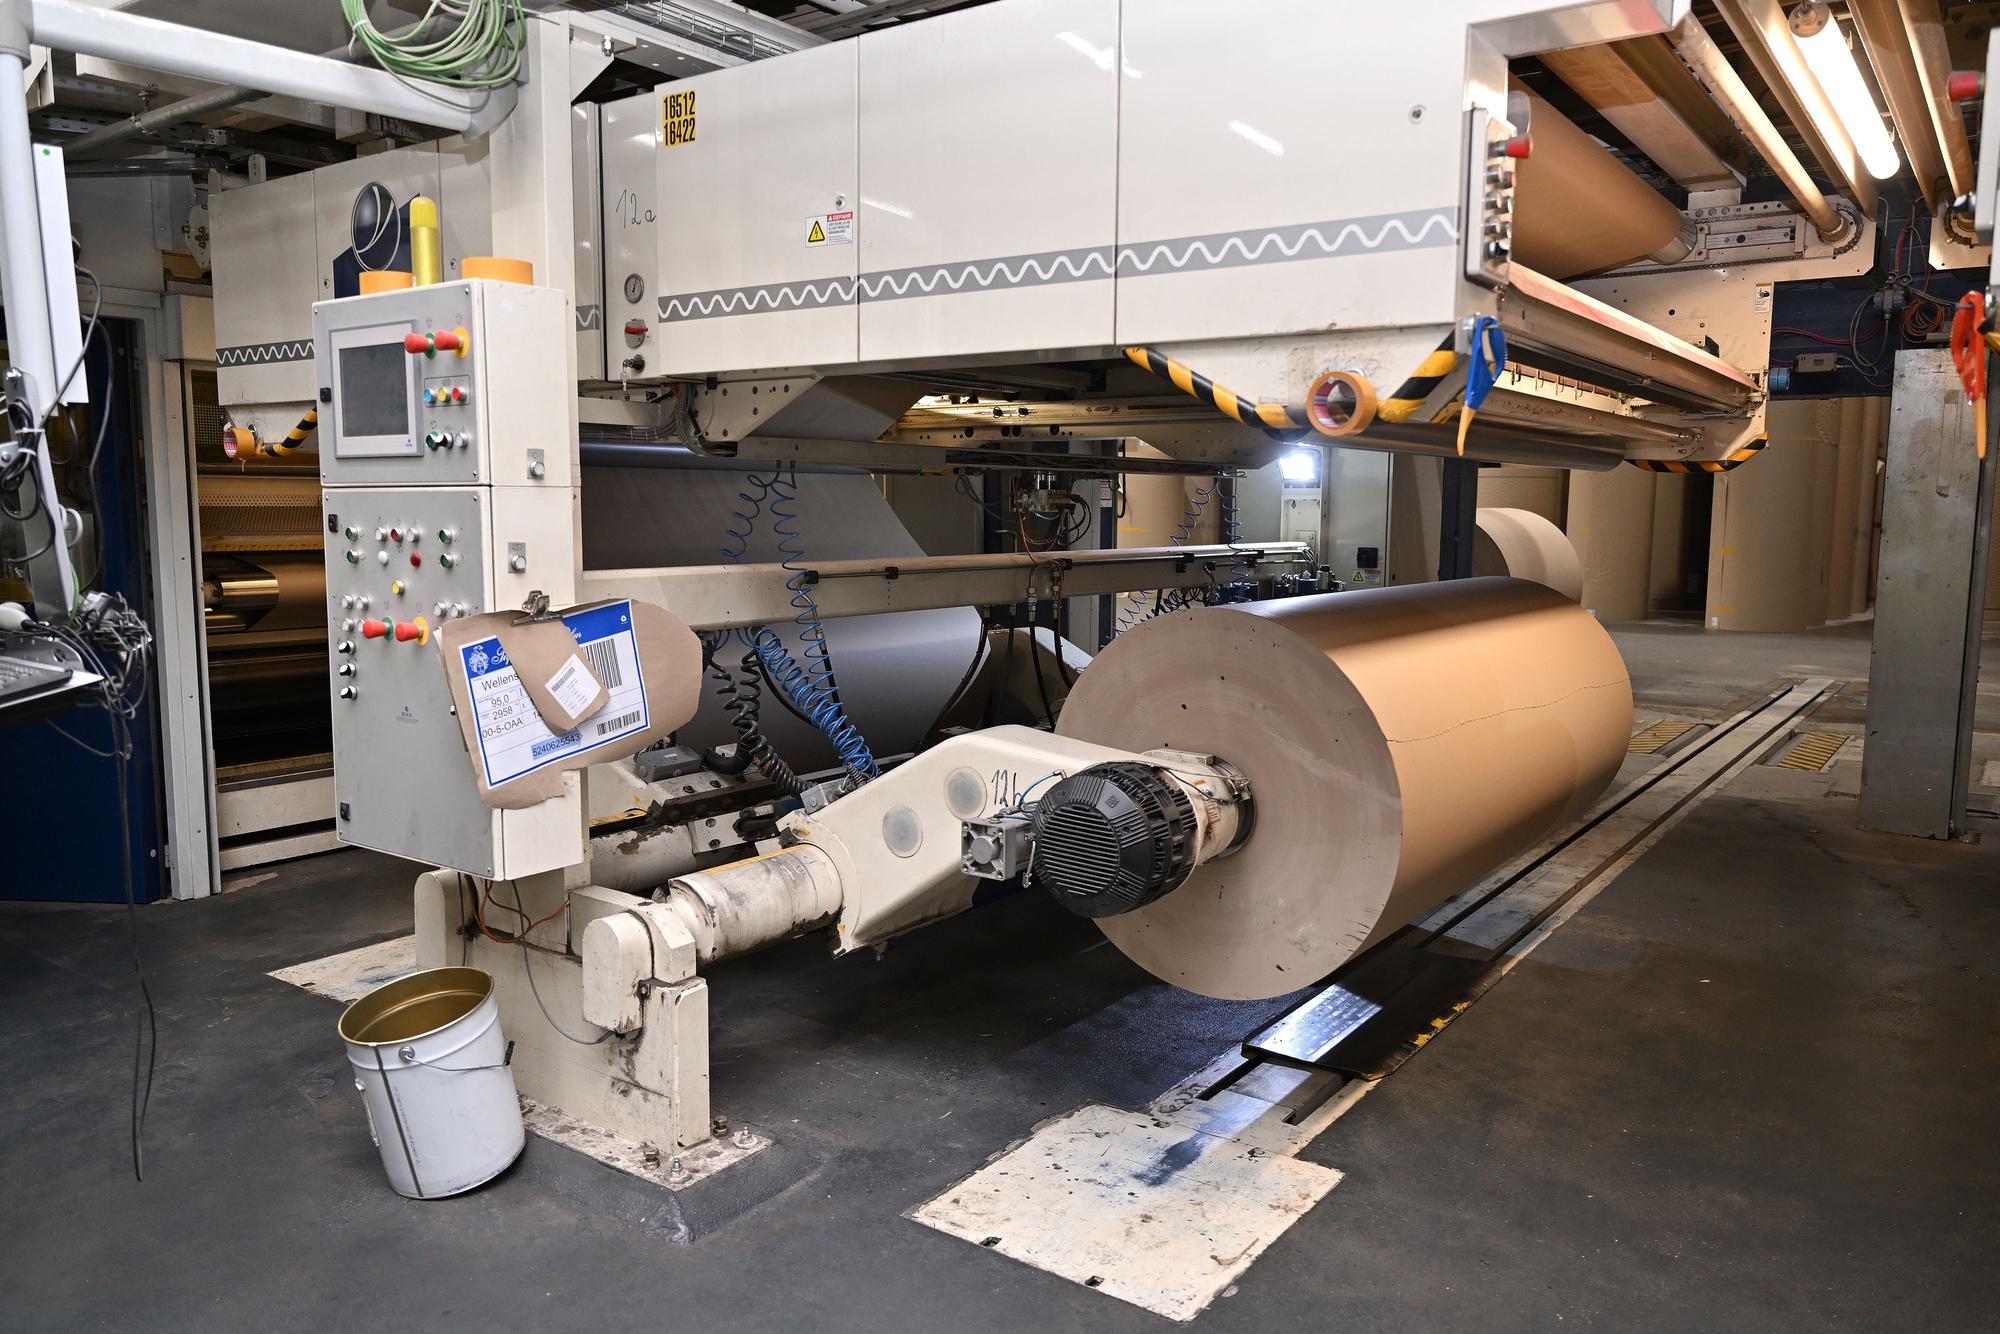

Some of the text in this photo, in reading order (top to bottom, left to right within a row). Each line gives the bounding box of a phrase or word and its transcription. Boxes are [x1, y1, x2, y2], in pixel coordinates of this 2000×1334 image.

[663, 91, 696, 120] 16512
[663, 117, 696, 146] 16422
[615, 189, 657, 229] 12a
[493, 706, 513, 721] 2958
